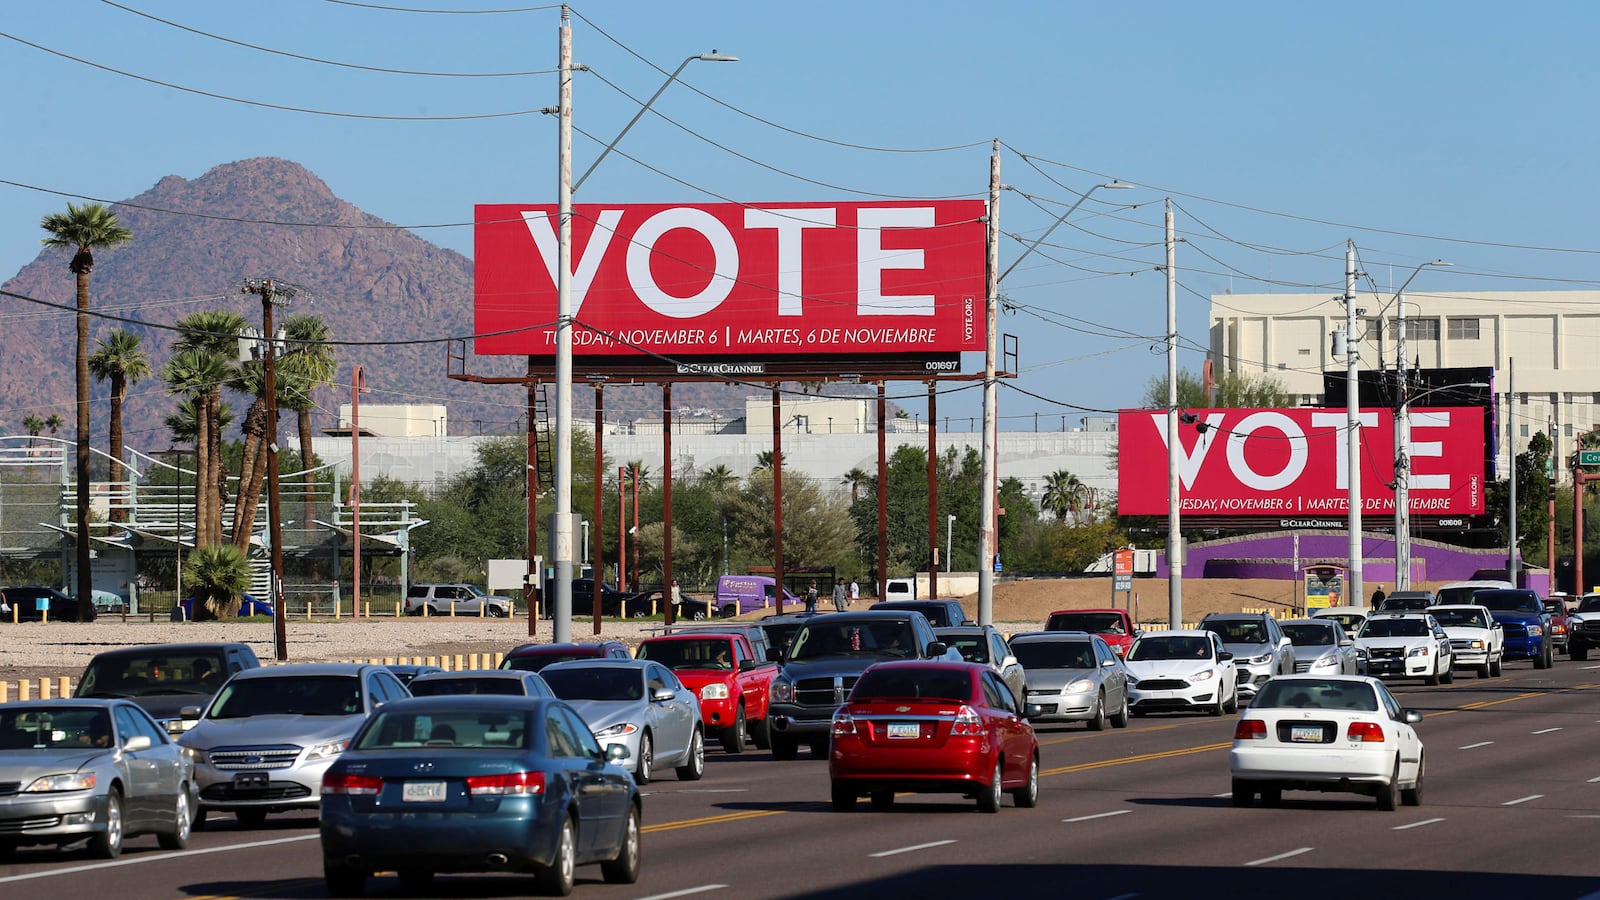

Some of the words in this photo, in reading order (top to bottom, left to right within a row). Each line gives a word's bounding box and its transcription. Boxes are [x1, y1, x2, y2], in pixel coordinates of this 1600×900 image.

[520, 206, 935, 319] VOTE
[965, 298, 973, 341] VOTE.ORG
[543, 330, 615, 348] TSDAY,
[617, 329, 704, 344] NOVEMBER
[708, 329, 718, 344] 6
[737, 328, 803, 346] MARTES,
[807, 329, 817, 344] 6
[820, 328, 840, 344] DE
[844, 328, 937, 344] NOVIEMBRE
[925, 361, 958, 371] 001697
[1150, 411, 1451, 491] VOTE
[1167, 498, 1218, 512] ESDAY,
[1220, 498, 1283, 510] NOVEMBER
[1285, 498, 1293, 510] 6
[1306, 498, 1349, 510] MARTE
[1366, 498, 1382, 510] DE
[1383, 498, 1450, 510] NIEMBRE
